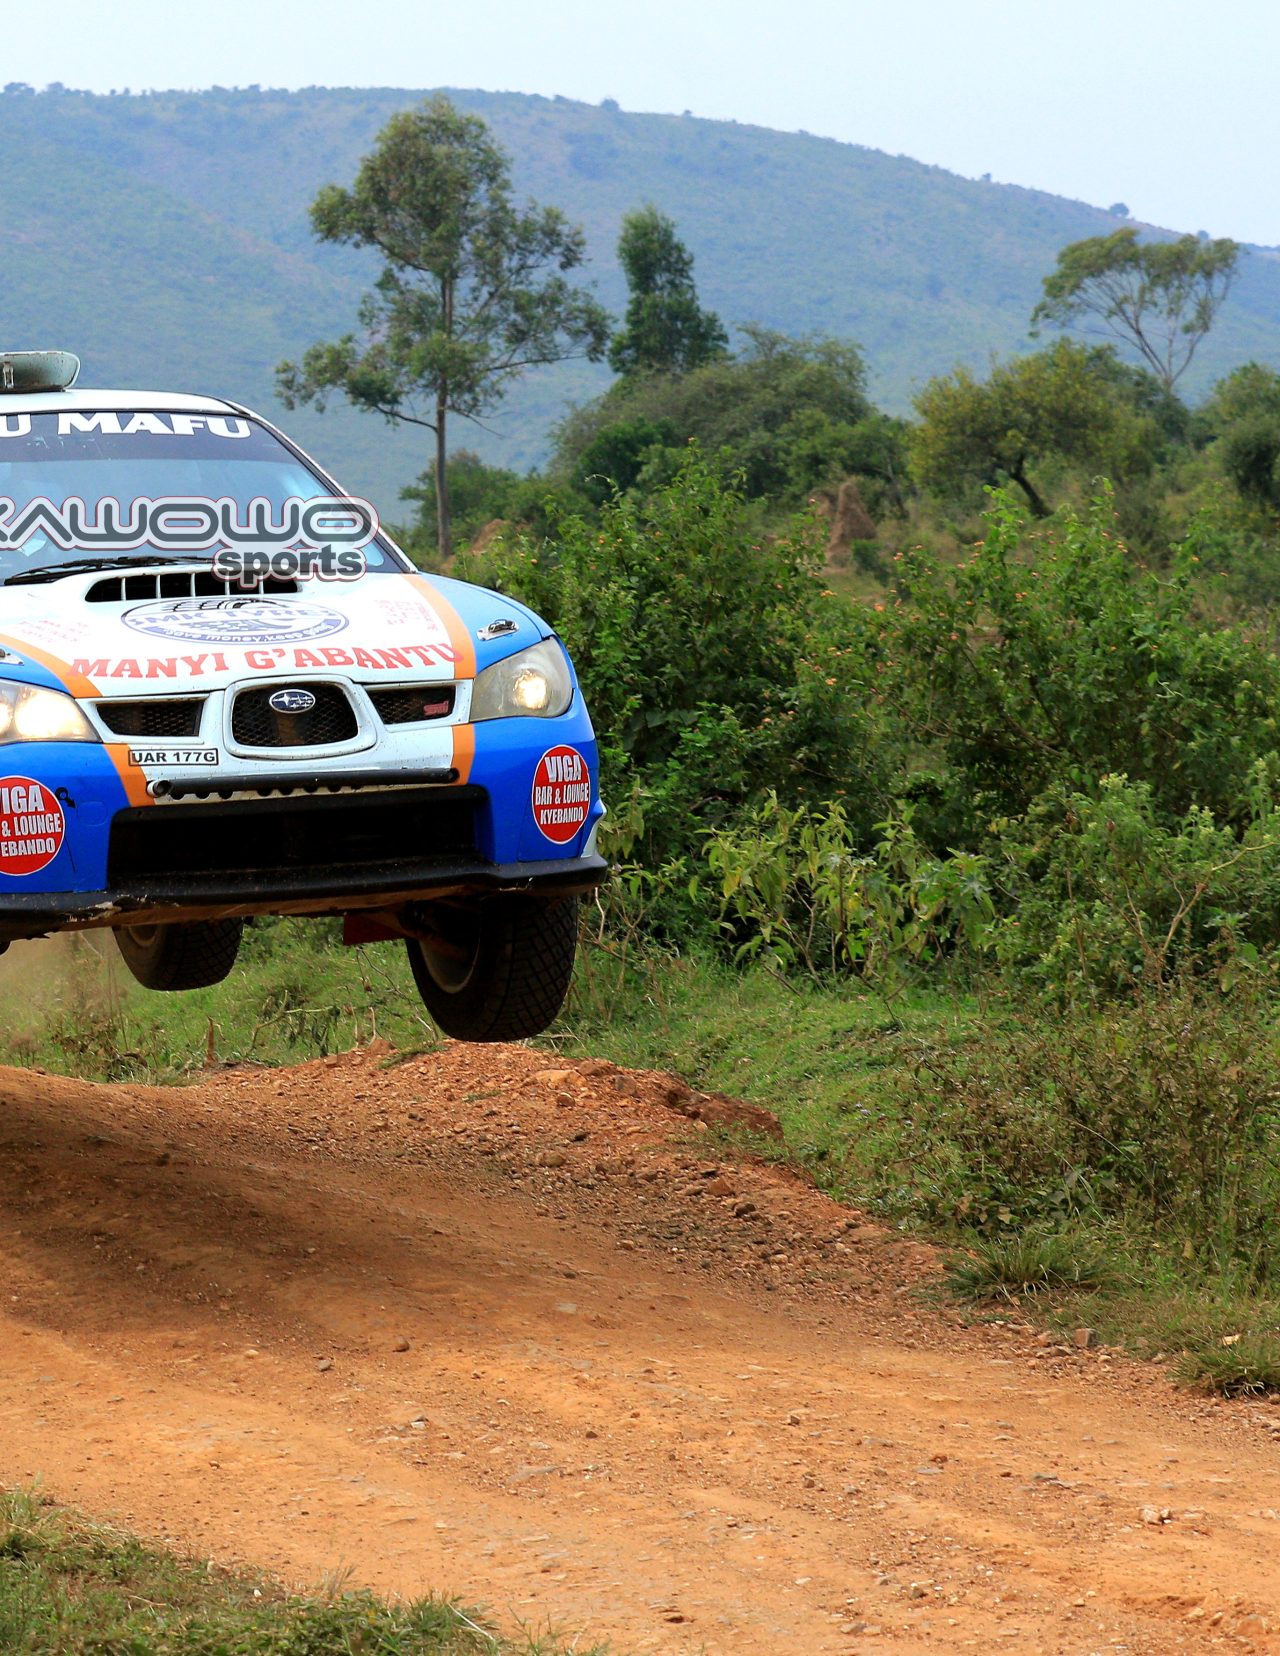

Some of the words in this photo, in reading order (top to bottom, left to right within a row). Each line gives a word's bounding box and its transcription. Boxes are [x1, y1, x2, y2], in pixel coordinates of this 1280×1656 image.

[58, 412, 251, 439] MAFU
[67, 653, 230, 678] MANYI
[243, 642, 465, 671] G'ABANTU
[132, 752, 167, 763] UAR
[173, 752, 216, 763] 177G
[545, 755, 582, 783] VIGA
[535, 785, 553, 805] BAR
[554, 788, 561, 804] &
[563, 783, 589, 804] LOUNGE
[1, 820, 11, 837] &
[13, 813, 62, 837] LOUNGE
[540, 806, 584, 825] KYEBANDO
